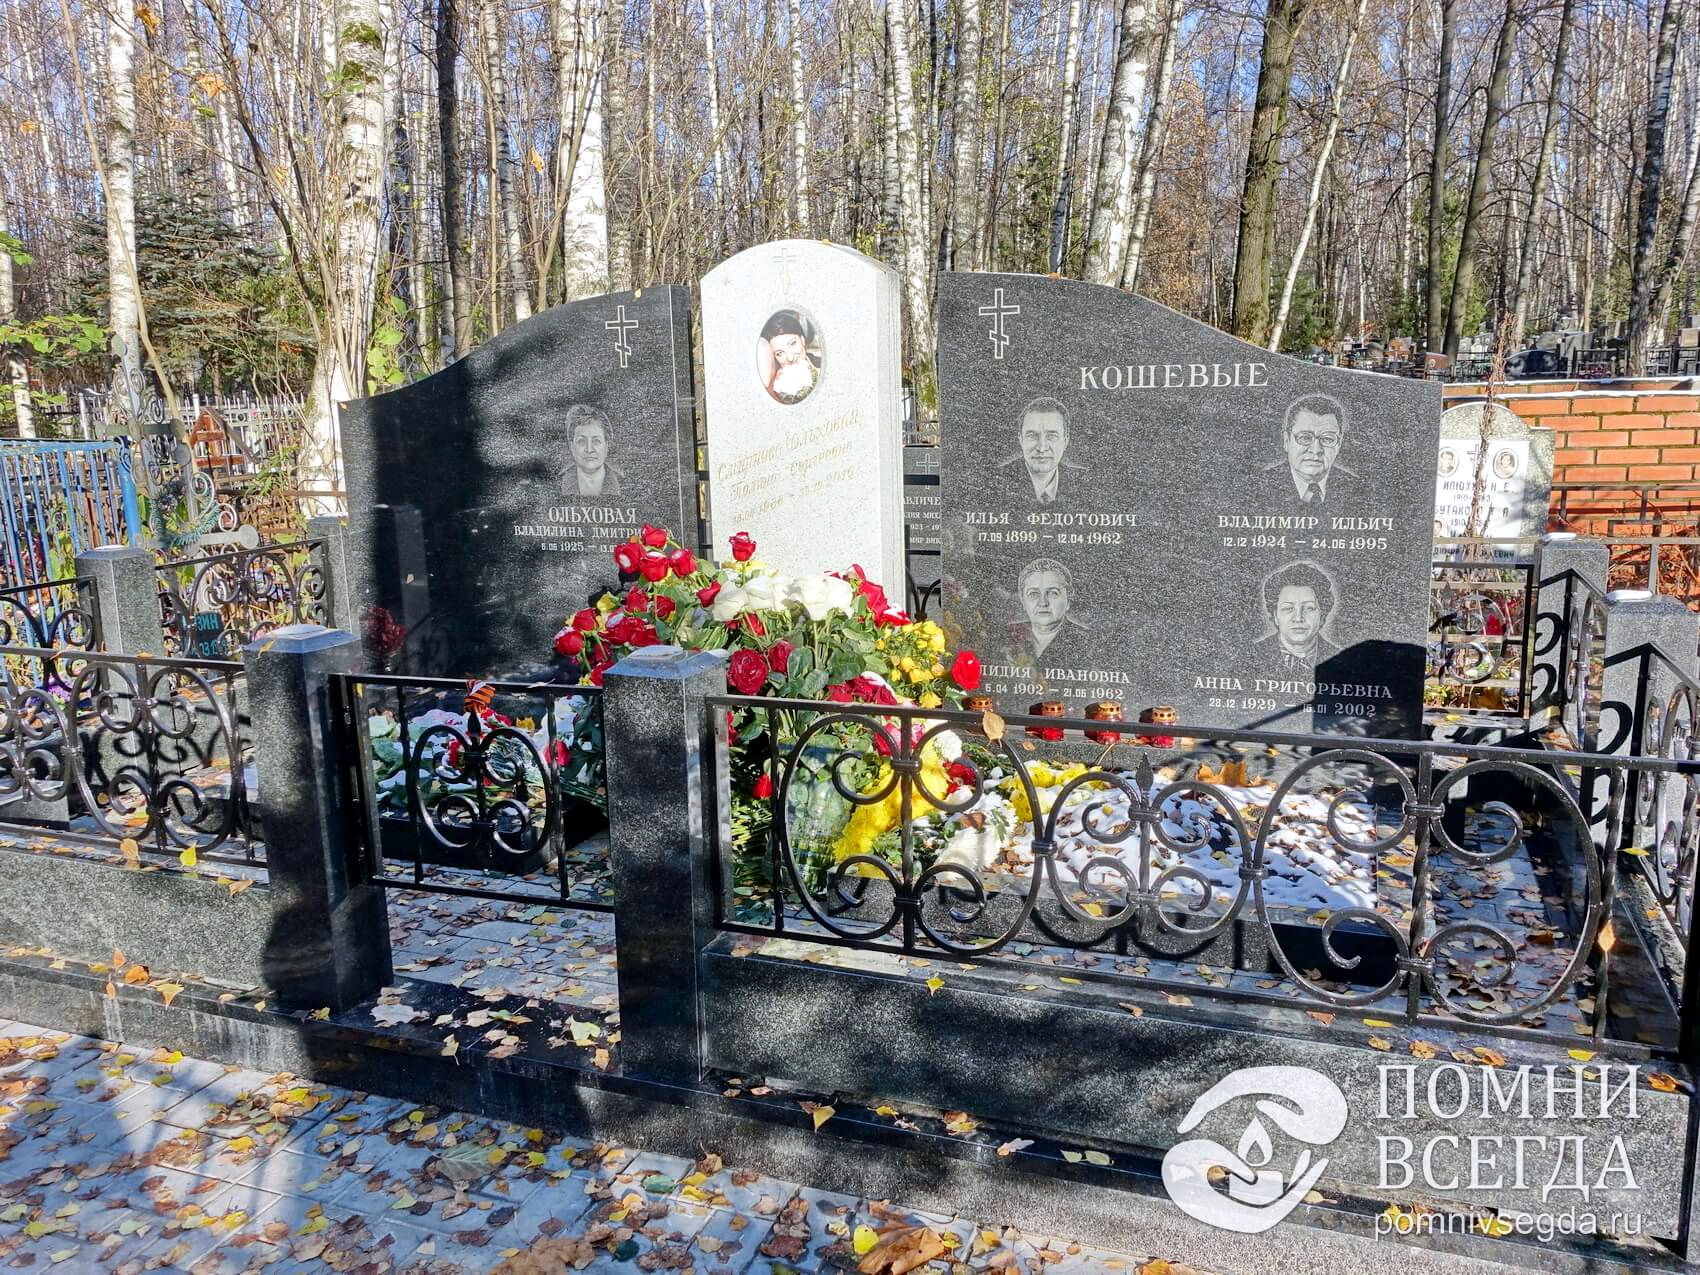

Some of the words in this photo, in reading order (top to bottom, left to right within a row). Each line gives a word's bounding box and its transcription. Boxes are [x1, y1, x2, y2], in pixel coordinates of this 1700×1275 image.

[1079, 363, 1269, 390] КОШЕВЫЕ
[548, 506, 637, 524] ОЛЬХОВАЯ
[966, 512, 1010, 525] ИЛЬЯ
[1027, 512, 1138, 528] ФЕДОТОВИЧ
[1217, 515, 1319, 530] ВЛАДИМИР
[1331, 517, 1394, 531] ИЛЬИЧ
[514, 525, 584, 538] ВЛАДИЛИНА
[1005, 530, 1037, 543] 1899
[1057, 533, 1084, 544] 12.04
[1087, 531, 1121, 545] 1962
[560, 541, 584, 552] 1925
[1223, 537, 1247, 547] 12.12
[1252, 535, 1287, 548] 1924
[1312, 538, 1345, 549] 24.06
[1349, 537, 1388, 550] 1995
[979, 664, 1032, 679] ЛИДИЯ
[1045, 668, 1131, 684] ИВАНОВНА
[1013, 682, 1044, 696] 1902
[1091, 687, 1125, 700] 1962
[1193, 676, 1244, 691] АННА
[1254, 679, 1393, 699] ГРИГОРЬЕВНА
[1242, 697, 1276, 711] 1929
[1334, 702, 1376, 718] 2002
